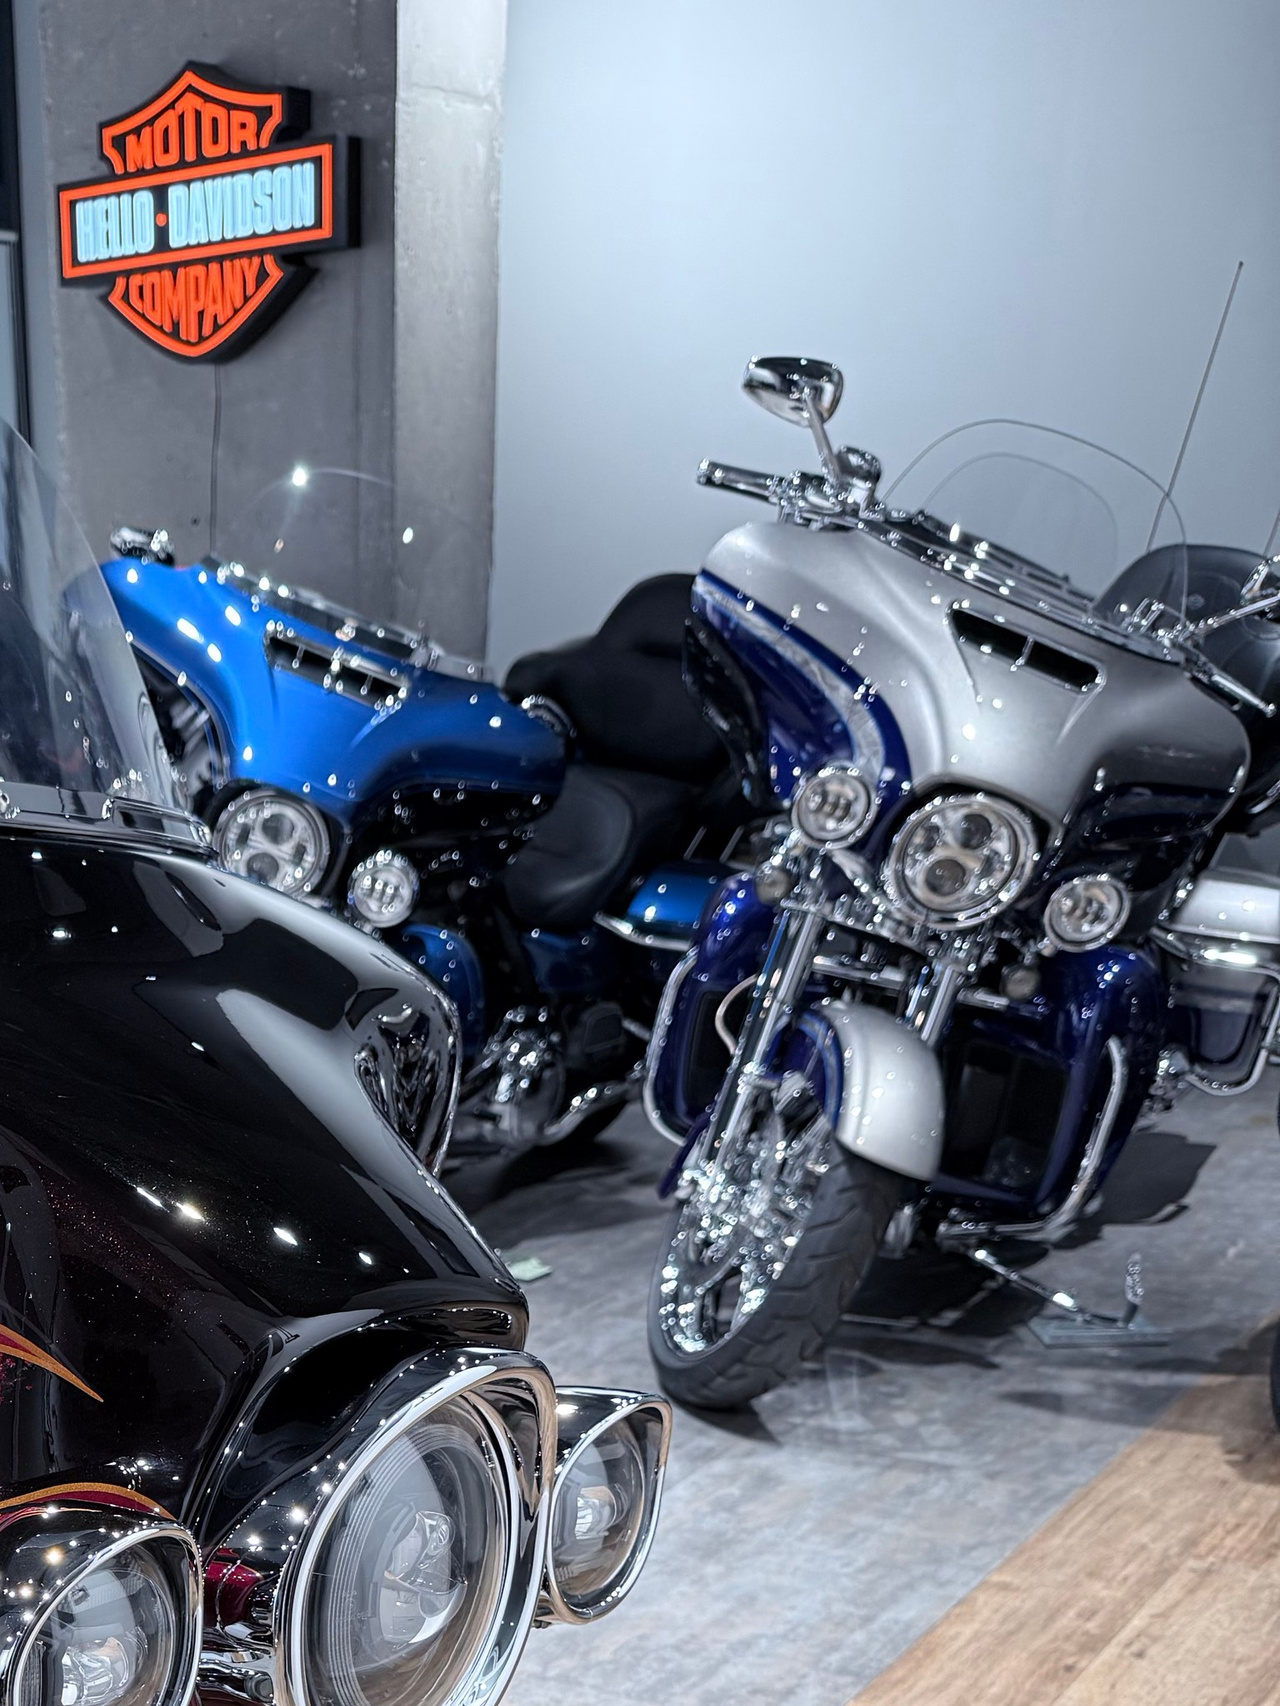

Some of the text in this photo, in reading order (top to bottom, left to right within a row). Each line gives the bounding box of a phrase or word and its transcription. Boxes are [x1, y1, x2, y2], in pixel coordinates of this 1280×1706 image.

[125, 91, 258, 172] MOTOR
[75, 162, 315, 263] HELLO DAVIDSON
[128, 255, 262, 342] COMPANY
